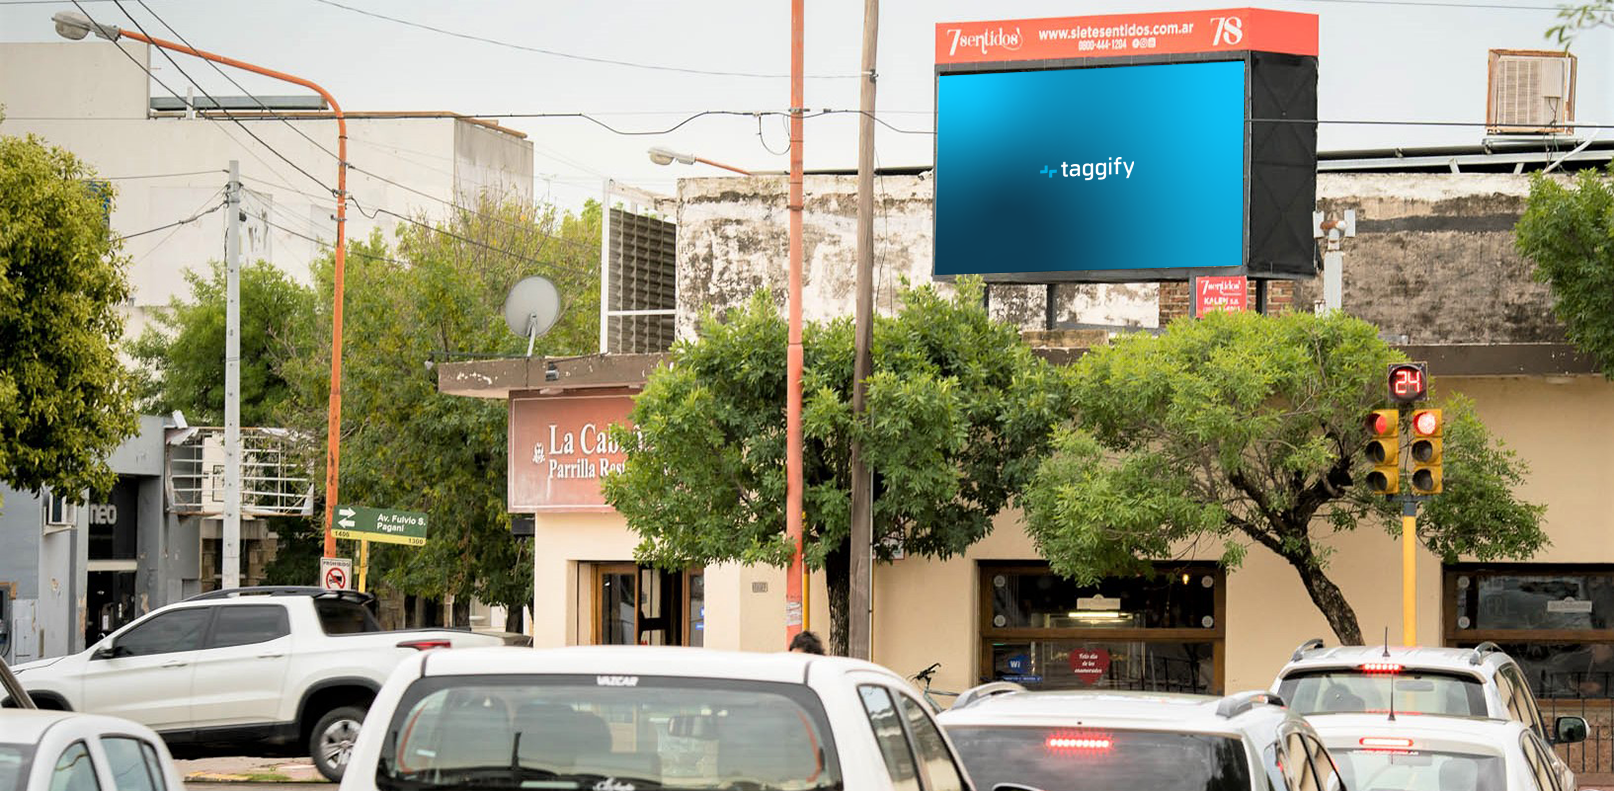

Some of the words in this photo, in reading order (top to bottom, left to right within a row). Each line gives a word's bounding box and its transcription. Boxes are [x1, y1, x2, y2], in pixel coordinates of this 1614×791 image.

[1038, 22, 1194, 40] www.sietesentidos.com.ar
[1060, 156, 1135, 181] taggify
[1395, 371, 1420, 394] 24
[549, 424, 574, 455] La
[549, 458, 595, 479] Parrilla
[376, 522, 405, 533] Pagani
[377, 513, 390, 523] Av.
[391, 514, 416, 525] Fulvio
[417, 517, 426, 526] S.
